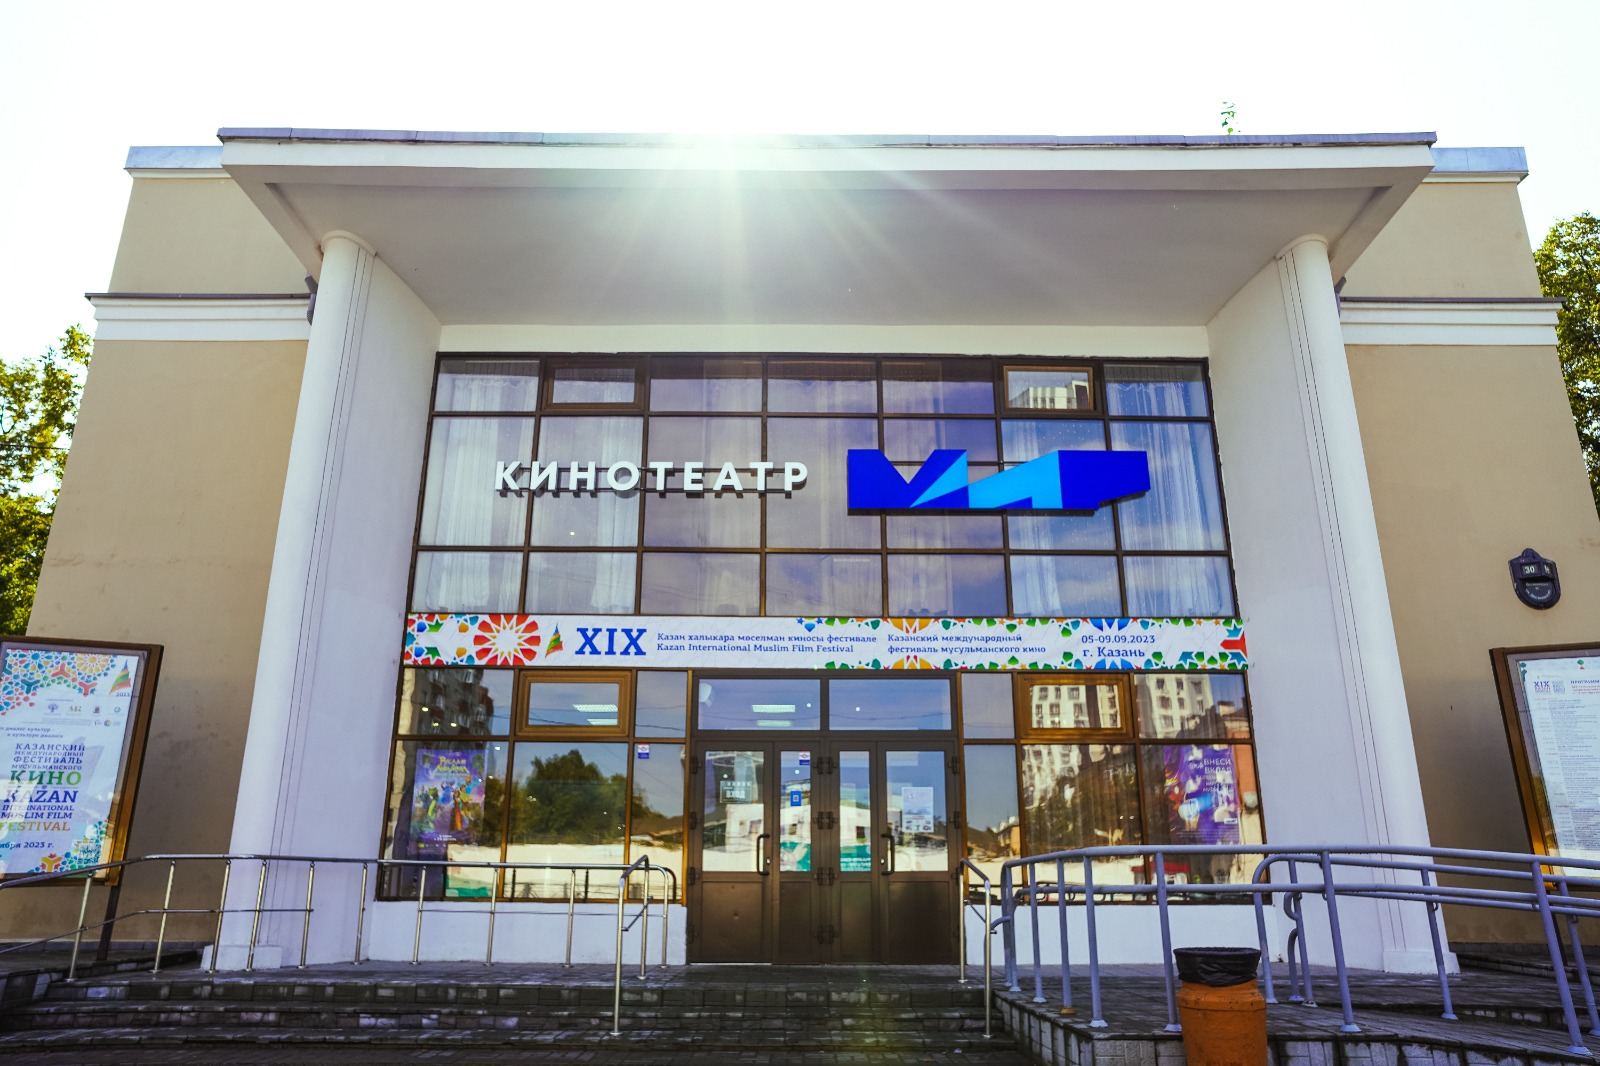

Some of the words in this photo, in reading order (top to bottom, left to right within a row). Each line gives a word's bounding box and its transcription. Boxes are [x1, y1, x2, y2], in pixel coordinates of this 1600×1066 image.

[494, 460, 808, 493] КИНОТЕАТР
[1524, 565, 1535, 574] 30
[575, 627, 647, 656] XIX
[657, 633, 685, 641] Казан
[688, 634, 735, 643] халыкара
[826, 634, 877, 643] фестивале
[887, 633, 939, 642] Казанский
[941, 633, 1022, 643] международный
[1081, 634, 1156, 644] 05-09.09.2023
[657, 643, 686, 651] Kazan
[688, 643, 751, 652] International
[753, 644, 789, 652] Muslim
[791, 644, 814, 653] Film
[816, 644, 854, 653] Festival
[887, 645, 938, 654] фестиваль
[941, 646, 1020, 654] мусульманского
[1083, 649, 1093, 657] г.
[1097, 646, 1146, 657] Казань
[8, 770, 82, 785] КИНО
[2, 804, 75, 812] INNATIONAL
[0, 811, 44, 819] MLIM
[23, 841, 46, 849] 2023
